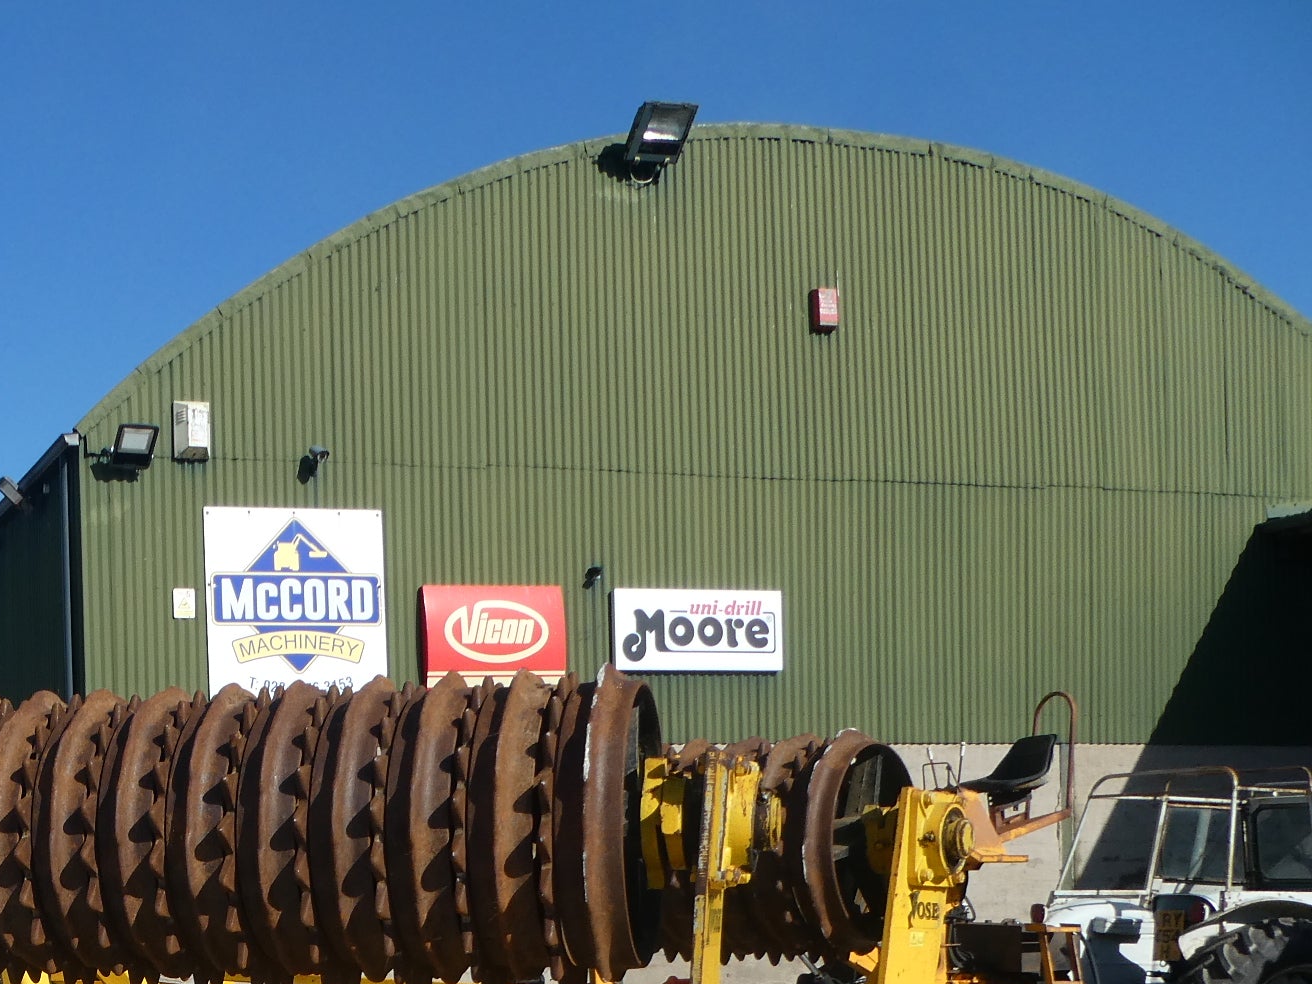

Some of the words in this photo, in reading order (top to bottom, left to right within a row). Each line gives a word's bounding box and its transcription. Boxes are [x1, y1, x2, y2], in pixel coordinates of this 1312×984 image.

[221, 578, 374, 621] McCORD
[689, 600, 762, 616] uni-drill
[460, 603, 535, 645] Vicon
[622, 608, 770, 663] Moore
[239, 634, 359, 658] MACHINERY
